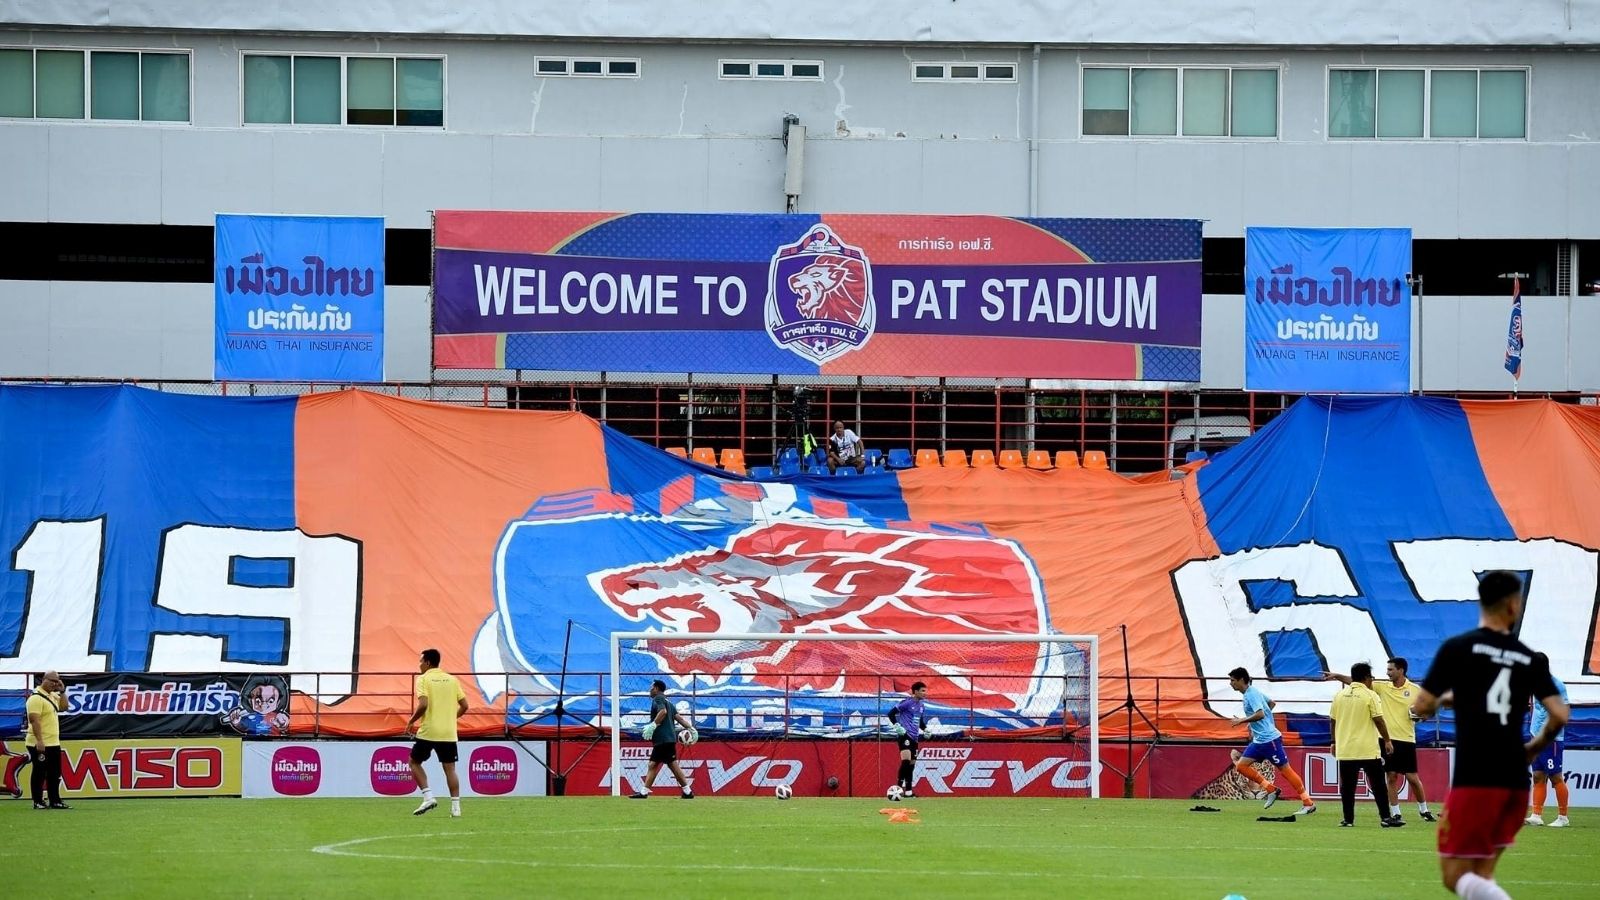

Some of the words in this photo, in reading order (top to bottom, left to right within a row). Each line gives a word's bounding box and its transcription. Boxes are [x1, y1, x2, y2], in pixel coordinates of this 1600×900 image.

[898, 237, 954, 250] การท่าเรือ
[225, 252, 374, 297] เมืองไทย
[474, 264, 678, 317] WELCOME
[694, 275, 747, 316] TO
[1255, 264, 1401, 307] เมืองไทย
[891, 279, 966, 320] PAT
[980, 275, 1157, 330] STADIUM
[248, 303, 351, 331] ประกันภัย
[1277, 313, 1379, 341] ประกันภัย
[226, 340, 267, 351] MUANG
[277, 340, 301, 351] THAI
[309, 341, 373, 352] INSURANCE
[1255, 350, 1296, 360] MUANG
[1306, 350, 1329, 360] THAI
[1337, 350, 1400, 361] INSURANCE
[1486, 667, 1513, 726] 4
[922, 747, 966, 759] HILUX
[1272, 754, 1281, 764] 5
[274, 759, 318, 772] เมืองไทย
[373, 759, 412, 772] เมืองไท
[472, 759, 515, 772] เมืองไทย
[1547, 758, 1555, 770] 8
[599, 756, 804, 793] REVO
[911, 757, 1103, 793] REVO
